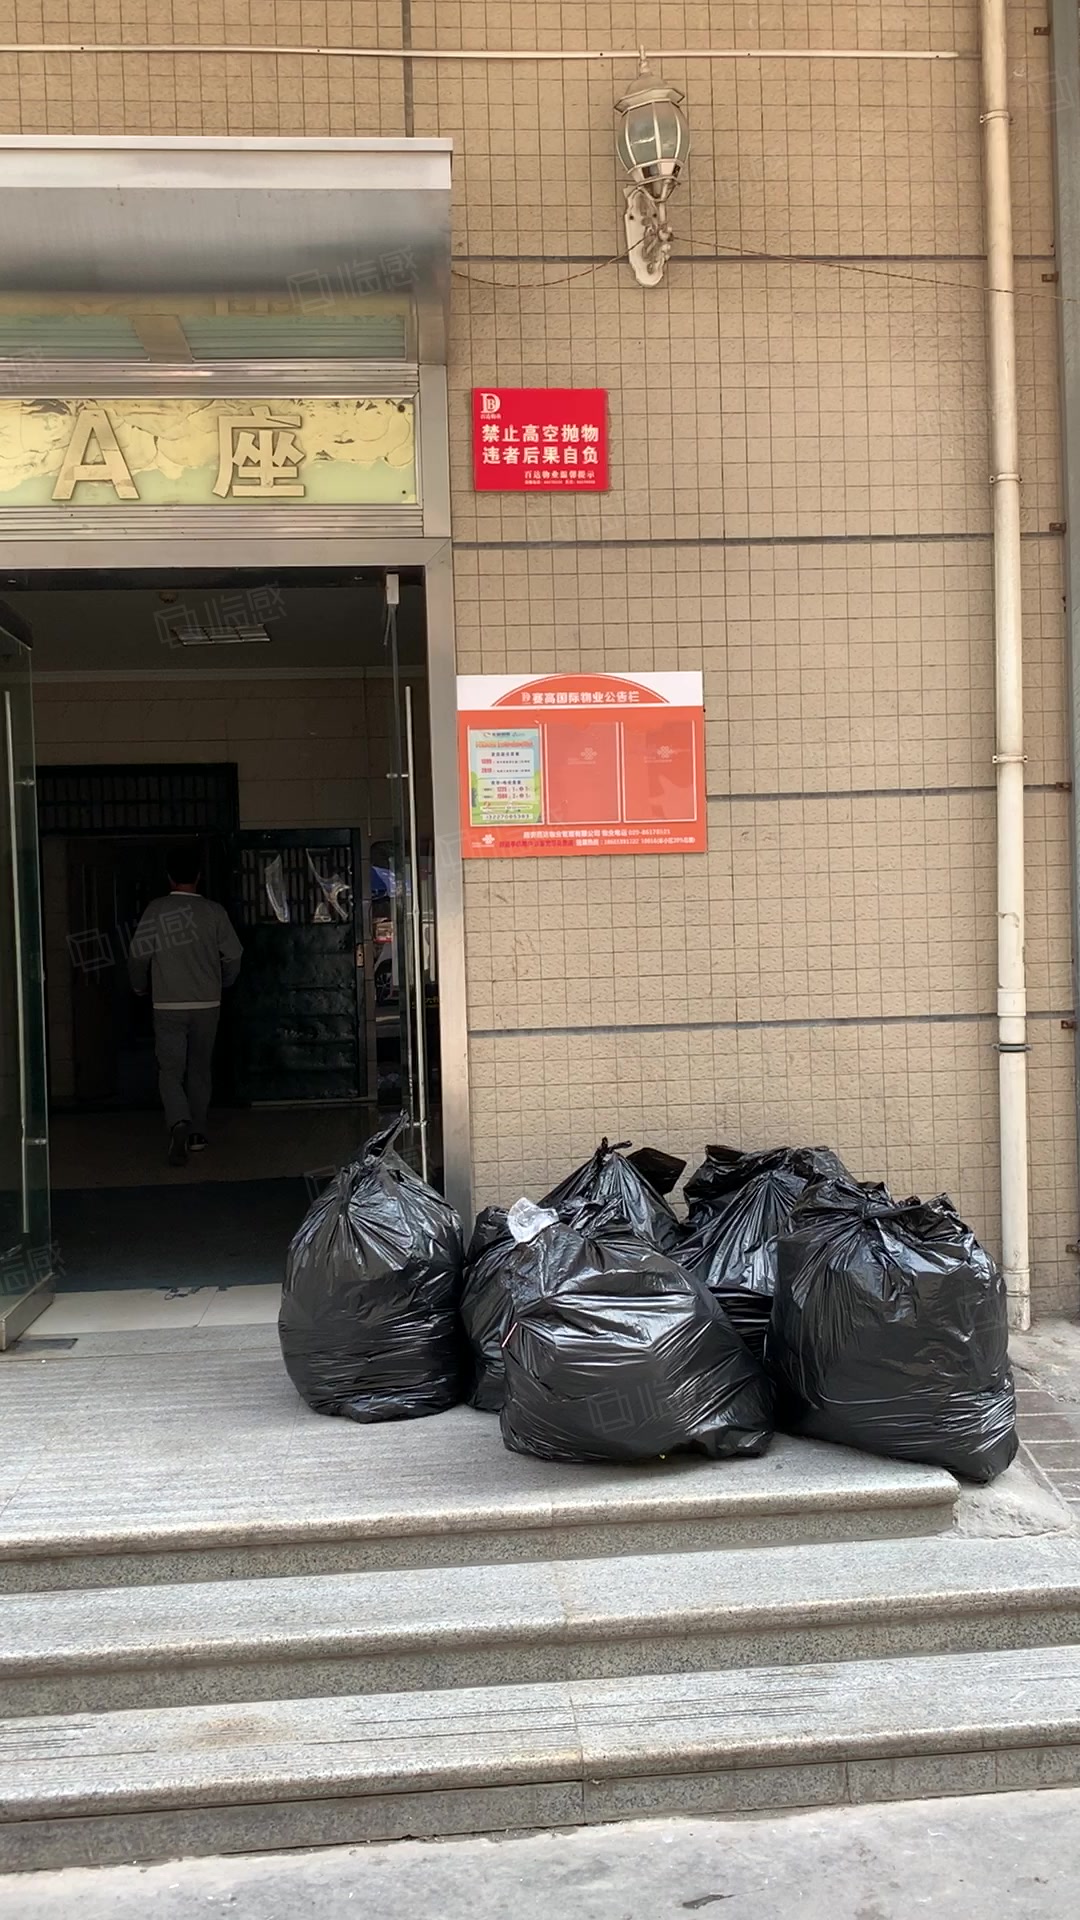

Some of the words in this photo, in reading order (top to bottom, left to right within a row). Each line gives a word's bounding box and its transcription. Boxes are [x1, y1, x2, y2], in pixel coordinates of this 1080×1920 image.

[481, 423, 600, 443] 禁止高空抛物
[481, 445, 600, 465] 违者后果自负
[532, 690, 640, 705] 赛高国际物业公告栏
